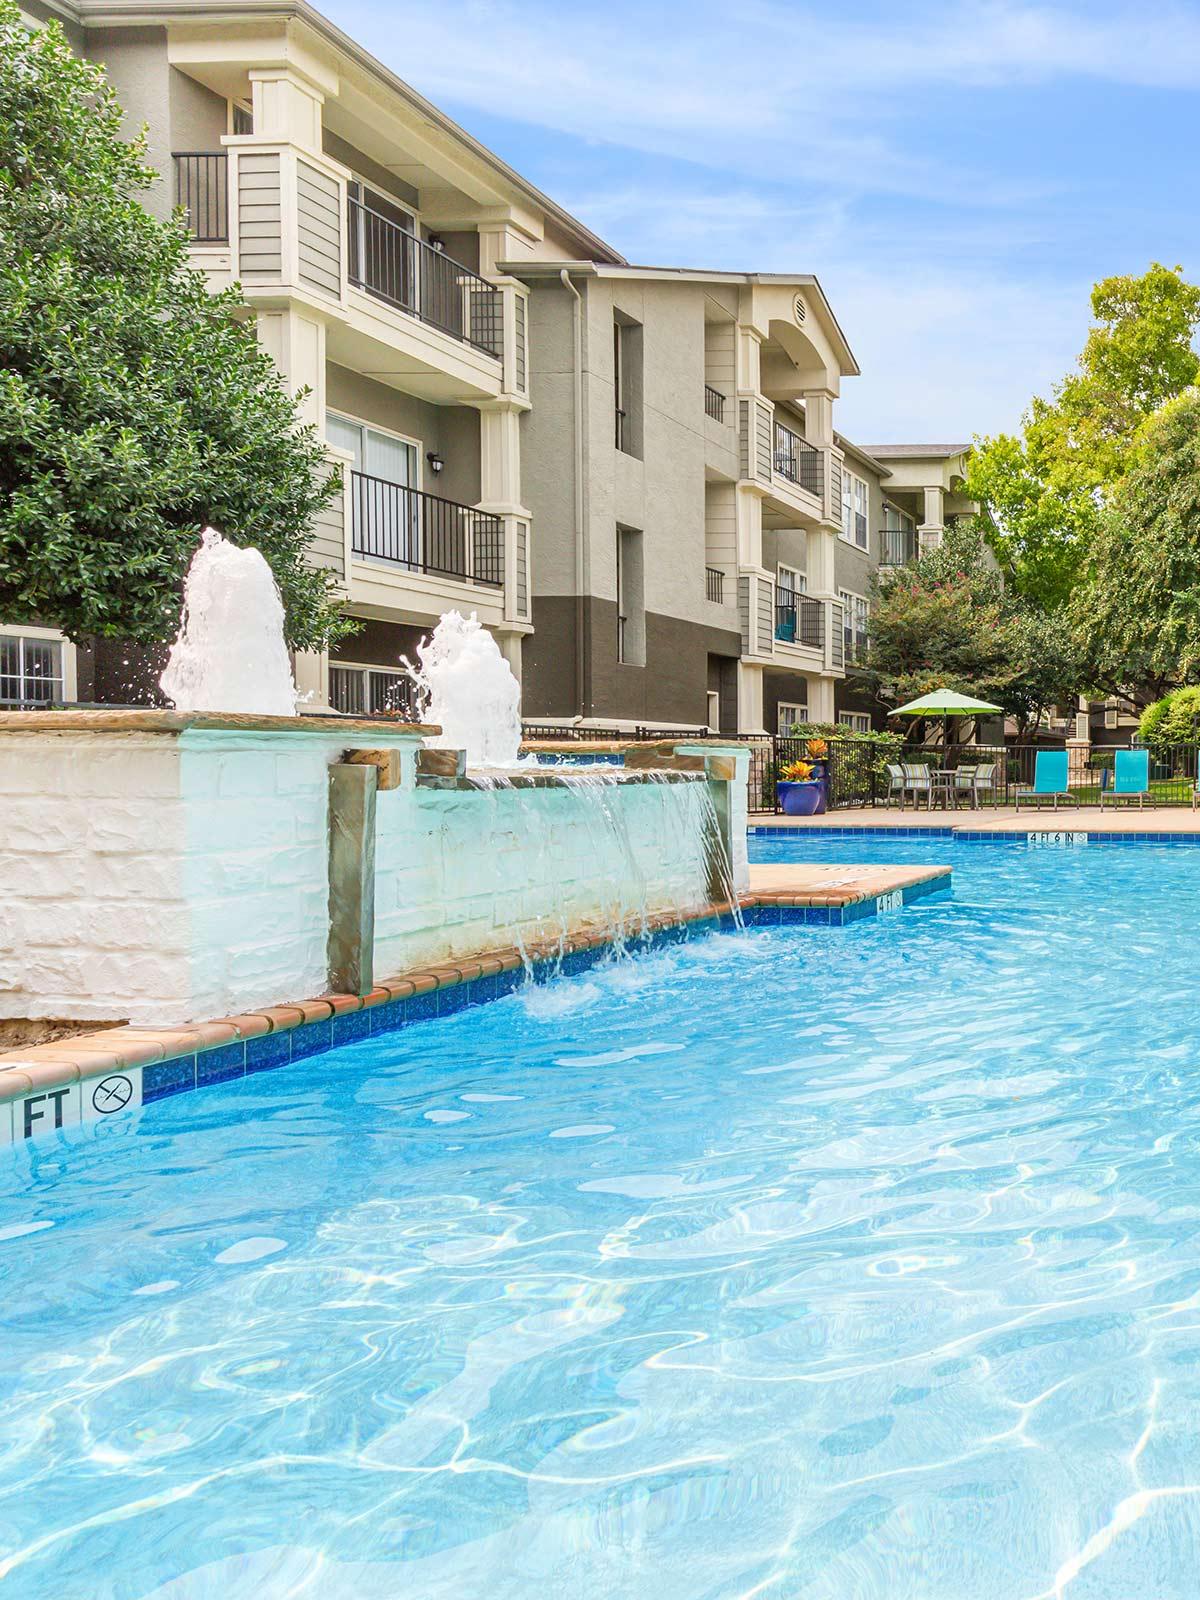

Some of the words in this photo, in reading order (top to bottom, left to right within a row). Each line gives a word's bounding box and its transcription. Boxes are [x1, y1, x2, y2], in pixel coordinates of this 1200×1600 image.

[1030, 833, 1036, 841] 4
[1041, 833, 1049, 842] FT
[1054, 832, 1061, 841] 6
[1065, 832, 1074, 843] IN
[879, 896, 884, 912] 4
[24, 1088, 70, 1139] FT
